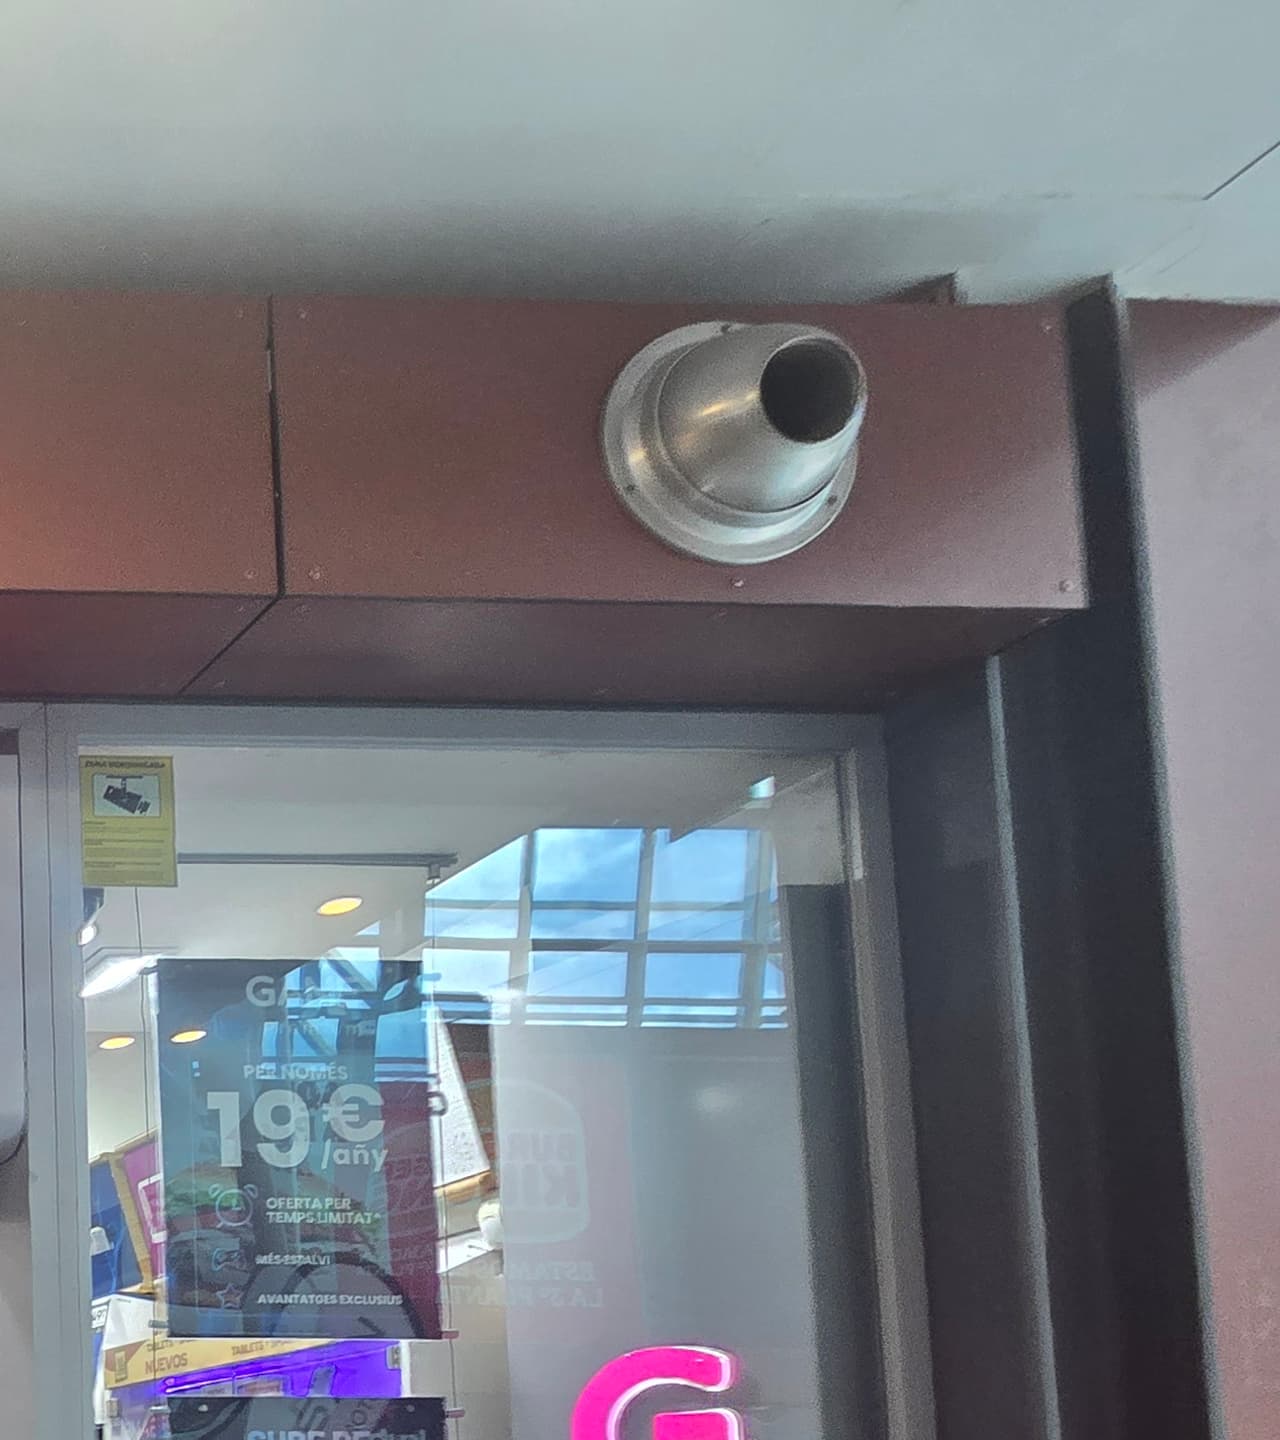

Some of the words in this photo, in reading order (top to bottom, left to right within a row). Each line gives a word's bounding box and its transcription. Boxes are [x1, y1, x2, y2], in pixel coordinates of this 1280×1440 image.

[243, 1065, 277, 1080] PER
[281, 1063, 349, 1080] NOMÉS
[266, 1198, 323, 1210] OFERTA
[324, 1198, 352, 1210] PER
[267, 1212, 313, 1224] TEMPS
[258, 1294, 338, 1305] AVANTATGES
[145, 1353, 188, 1374] NUEVOS
